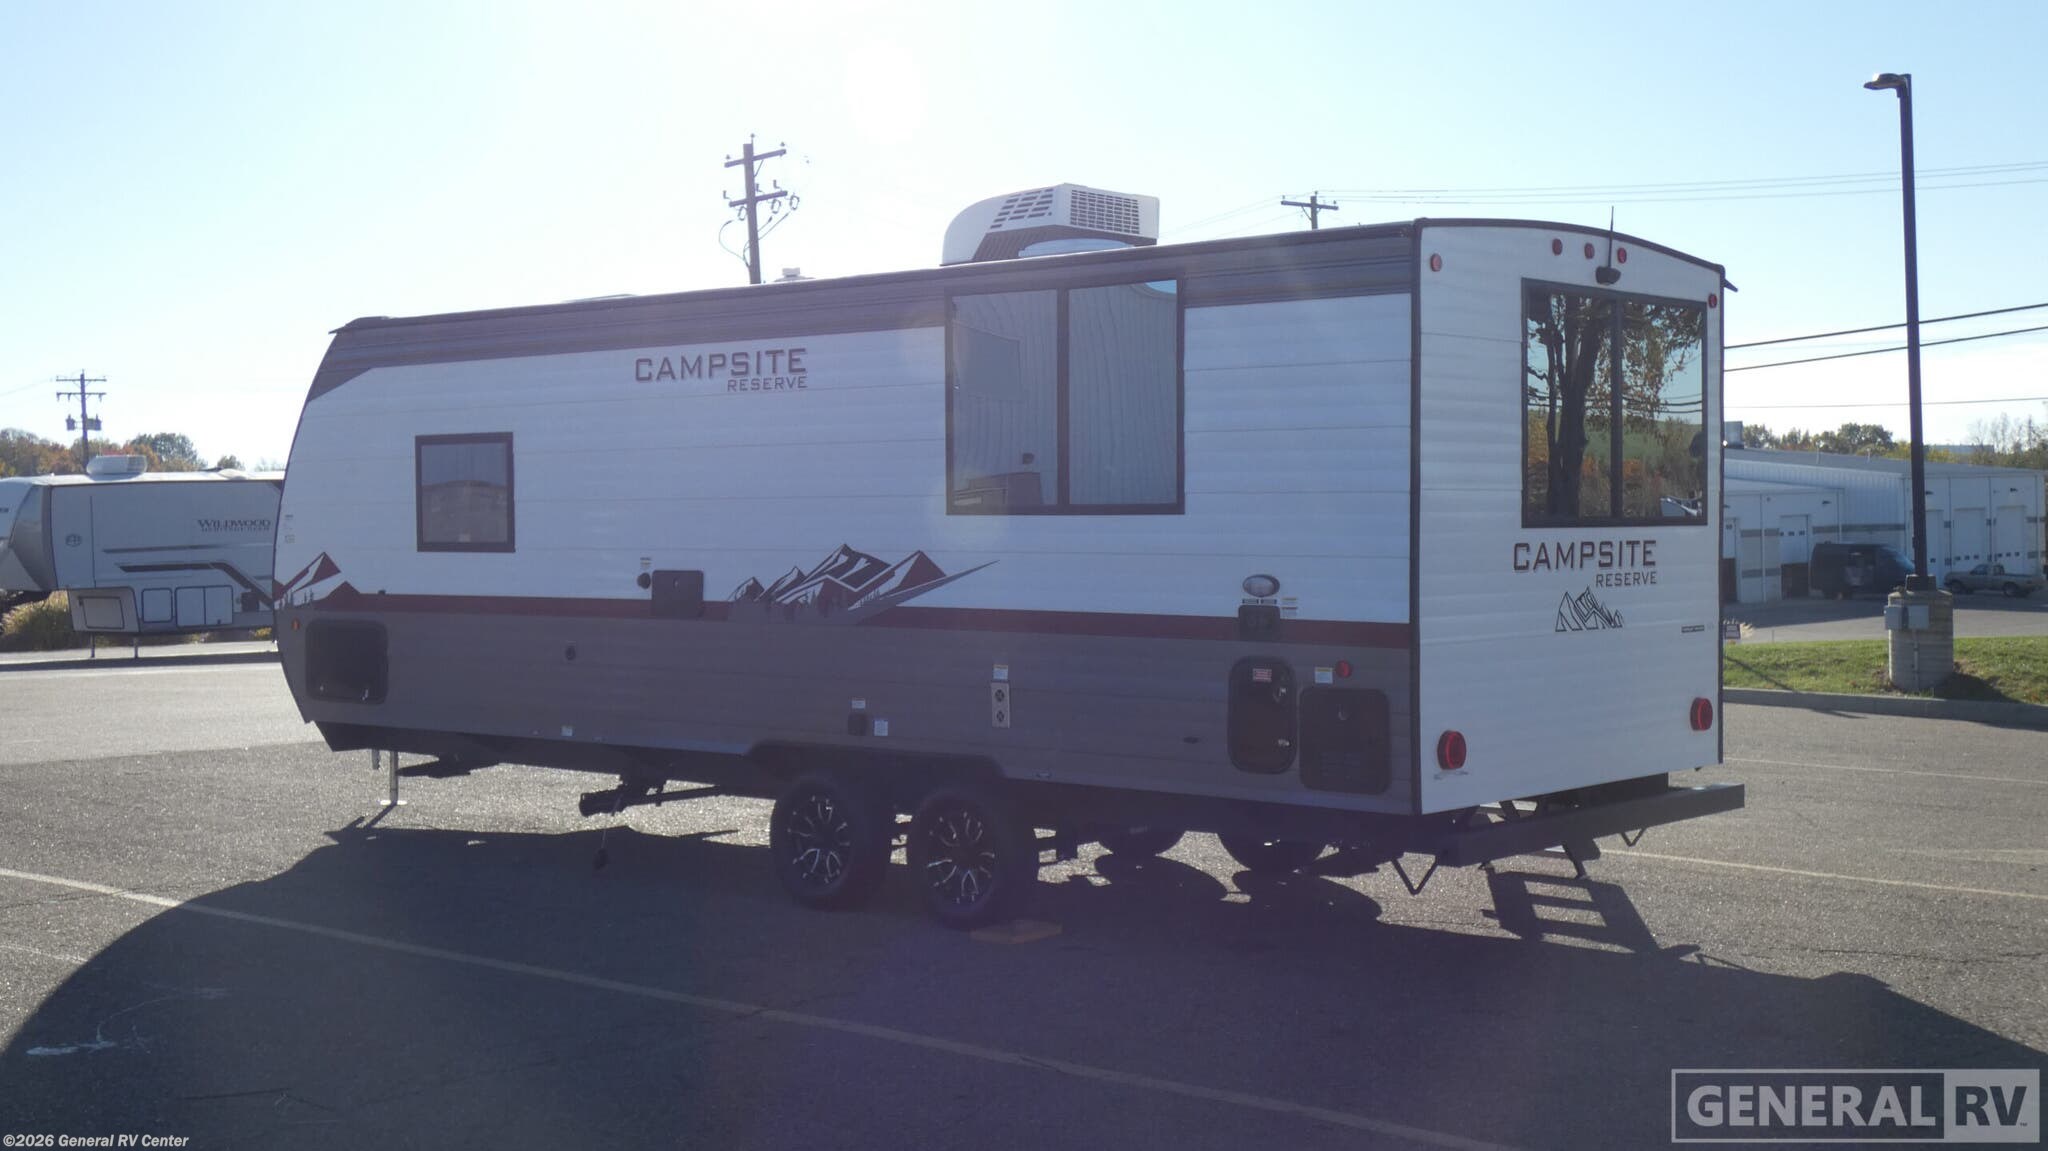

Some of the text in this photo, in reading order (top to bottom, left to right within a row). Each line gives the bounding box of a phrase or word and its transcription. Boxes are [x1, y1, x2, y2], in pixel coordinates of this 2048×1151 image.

[635, 348, 807, 382] CAMPSITE
[727, 376, 808, 392] RESERVE
[1513, 540, 1657, 571] CAMPSITE
[1595, 571, 1658, 588] RESERVE
